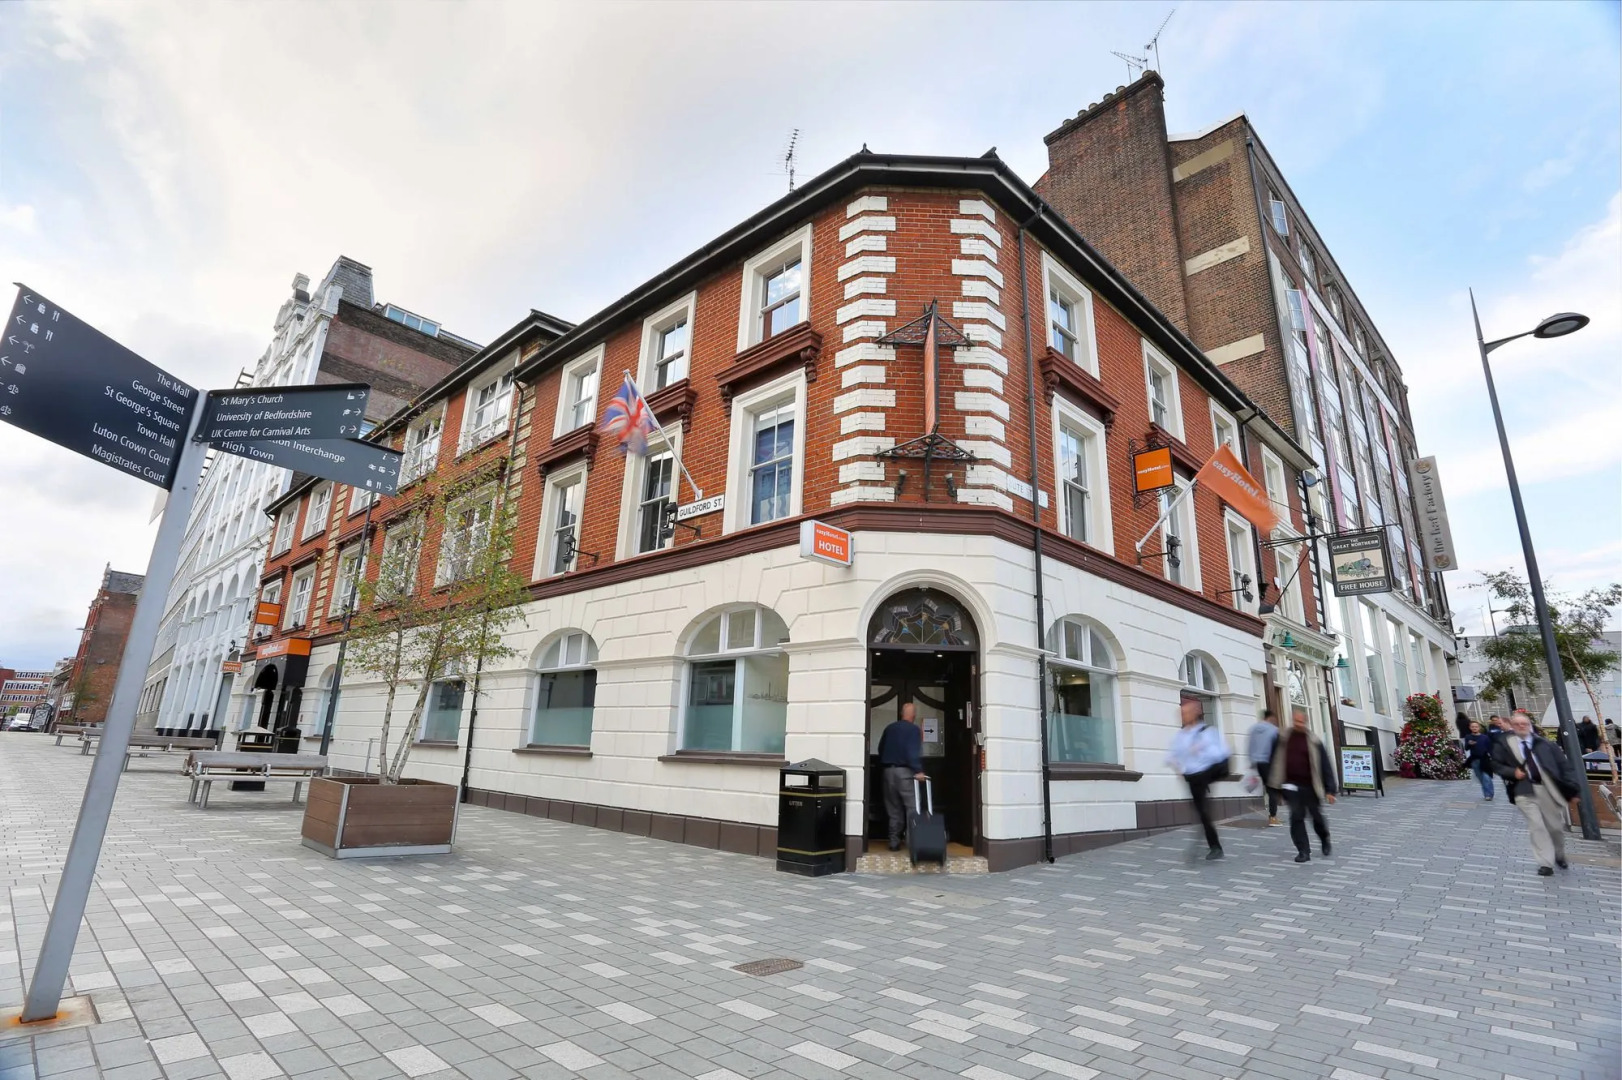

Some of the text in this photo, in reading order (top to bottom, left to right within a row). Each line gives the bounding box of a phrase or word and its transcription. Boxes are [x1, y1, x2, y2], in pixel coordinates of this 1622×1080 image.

[157, 373, 190, 398] The Mall
[132, 380, 185, 415] George Street
[221, 394, 283, 407] St Mary's Church
[104, 385, 180, 432] St George's Square
[216, 409, 312, 423] University of Bedfordshire
[136, 422, 175, 449] Town Hall
[211, 426, 311, 438] UK Centre for Carnival Arts
[92, 423, 170, 466] Luton Crown Court
[221, 441, 275, 461] High Town
[293, 439, 346, 463] Interchange
[91, 444, 165, 483] Magistrates Court
[679, 498, 722, 517] GUILDFORD ST.
[818, 540, 844, 556] HOTEL
[1351, 539, 1379, 547] NORTHERN
[1434, 538, 1444, 554] the
[1360, 580, 1384, 589] HOUSE
